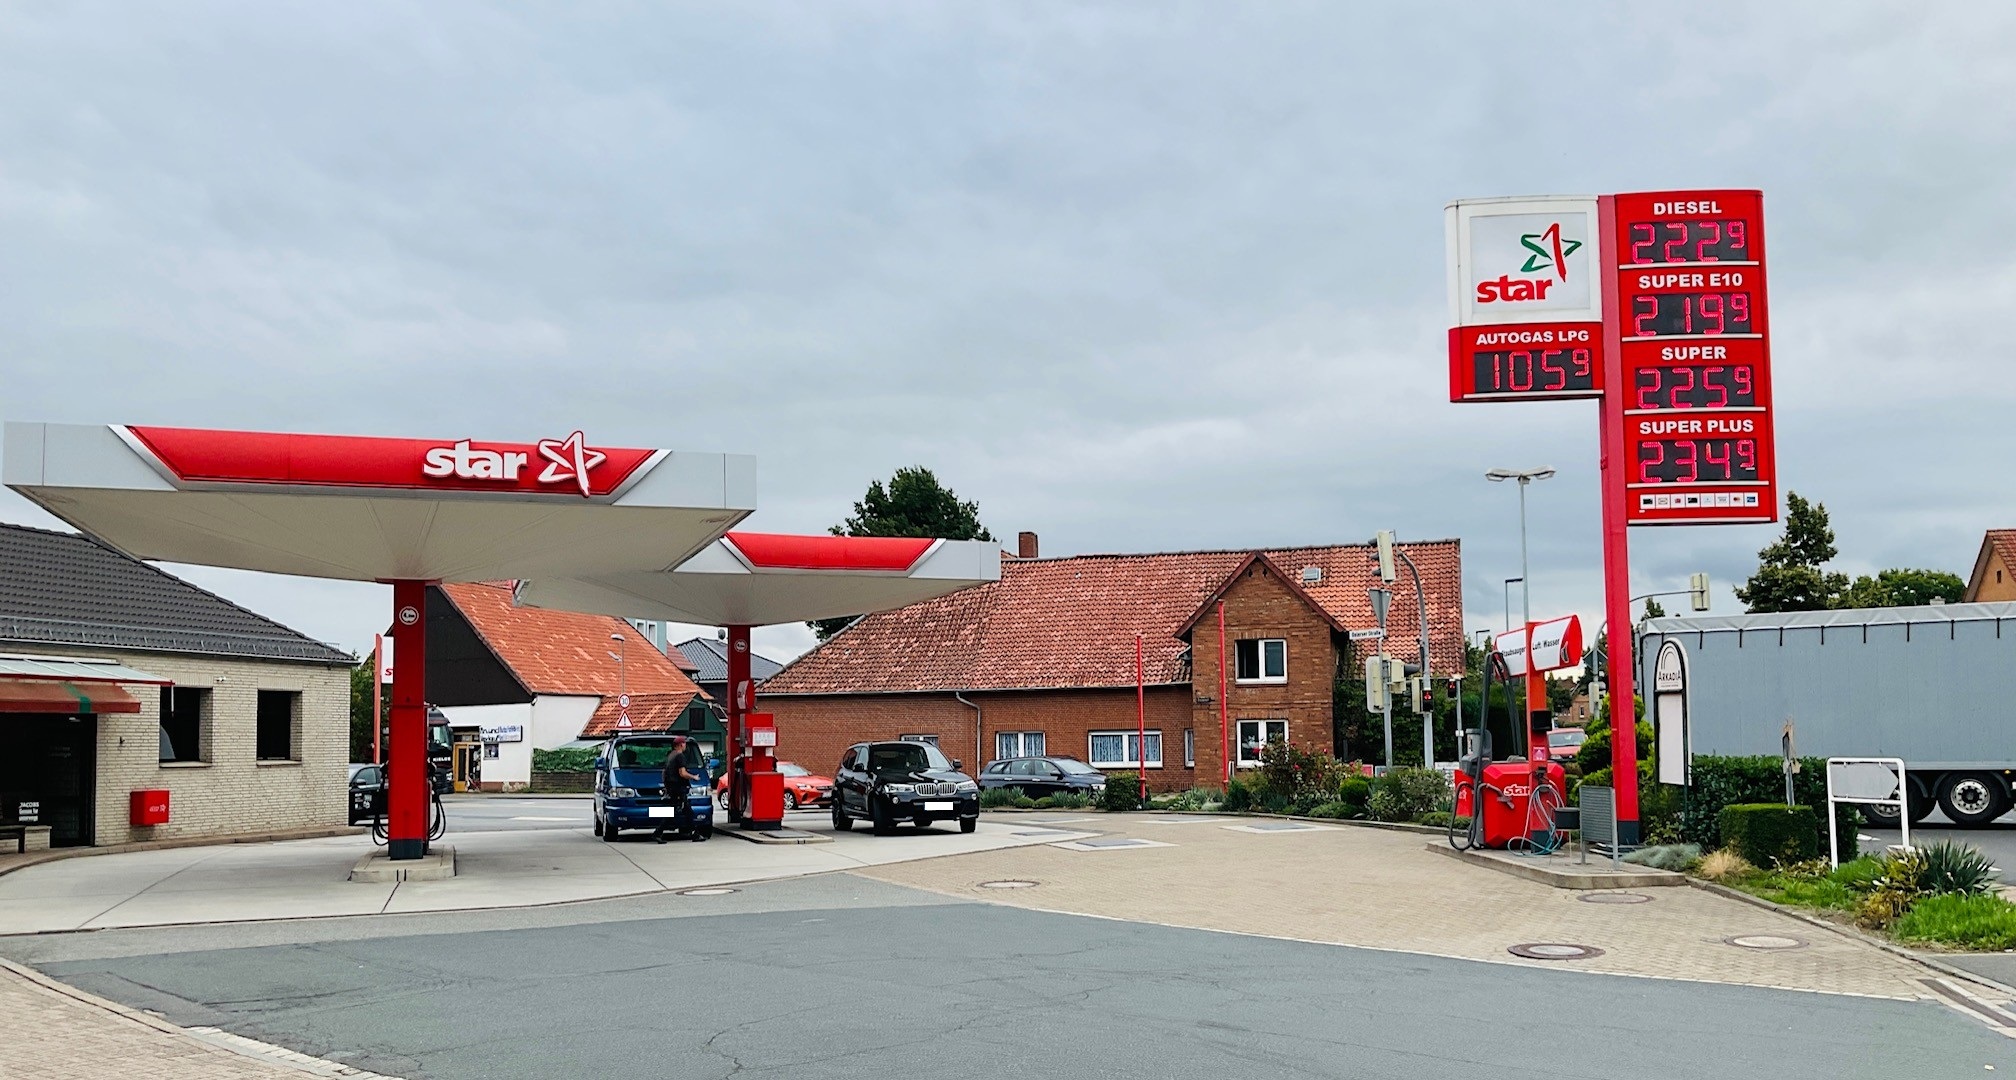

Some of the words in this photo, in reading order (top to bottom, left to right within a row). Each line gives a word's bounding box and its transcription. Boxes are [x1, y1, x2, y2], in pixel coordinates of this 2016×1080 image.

[1653, 201, 1722, 215] DIESEL
[1638, 274, 1704, 289] SUPER
[1709, 272, 1743, 287] E10
[1477, 274, 1553, 303] star
[1476, 331, 1553, 345] AUTOGAS
[1558, 330, 1590, 341] LPG
[1661, 346, 1727, 361] SUPER
[1639, 421, 1702, 435] SUPER
[1707, 419, 1754, 433] PLUS
[423, 439, 528, 481] star
[622, 697, 628, 706] 30
